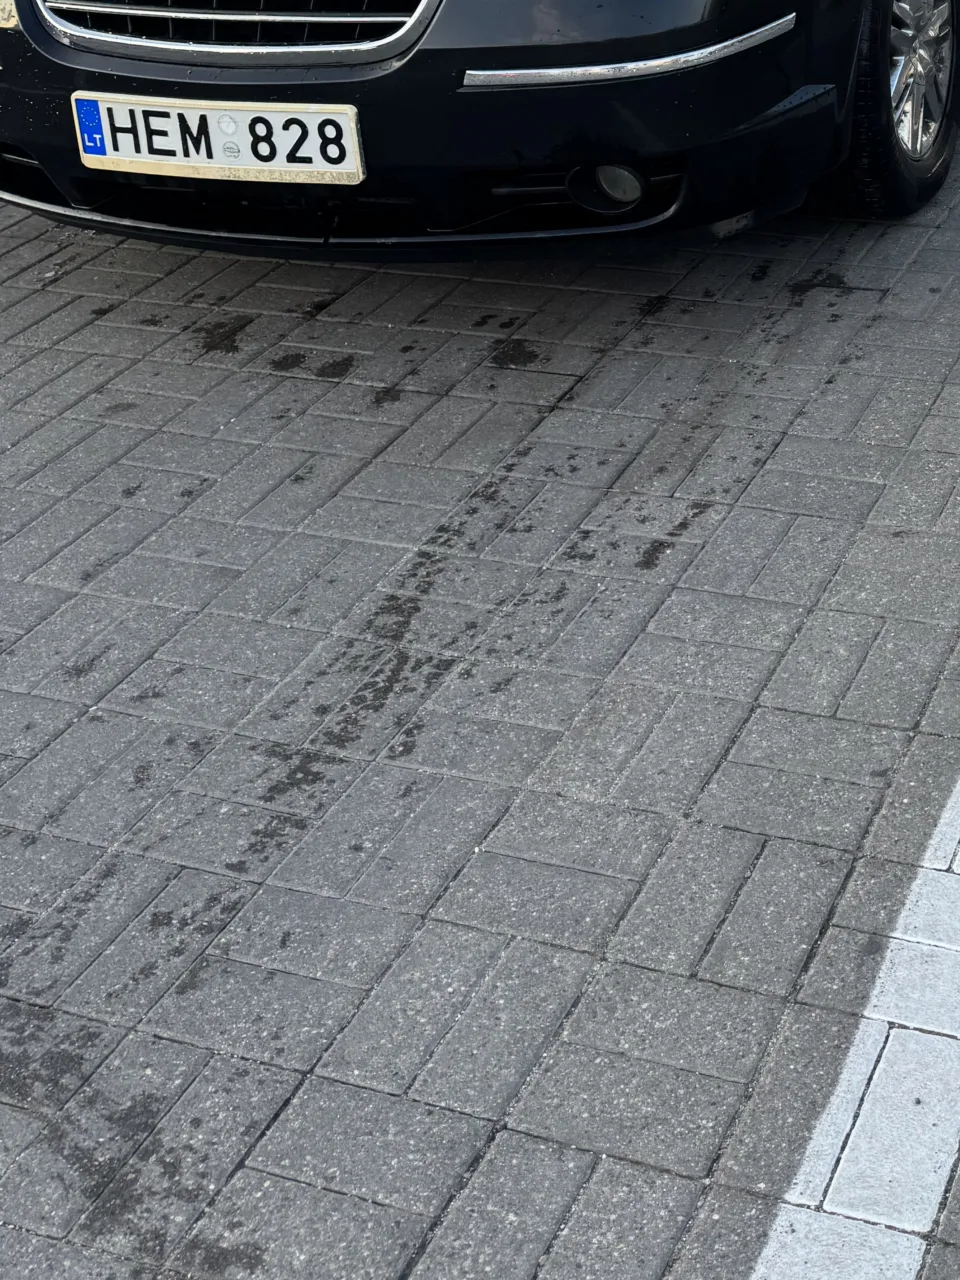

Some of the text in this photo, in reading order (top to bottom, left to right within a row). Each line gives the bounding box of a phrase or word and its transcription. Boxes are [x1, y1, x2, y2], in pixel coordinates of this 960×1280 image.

[84, 133, 102, 147] LT
[106, 106, 347, 165] HEM 828
